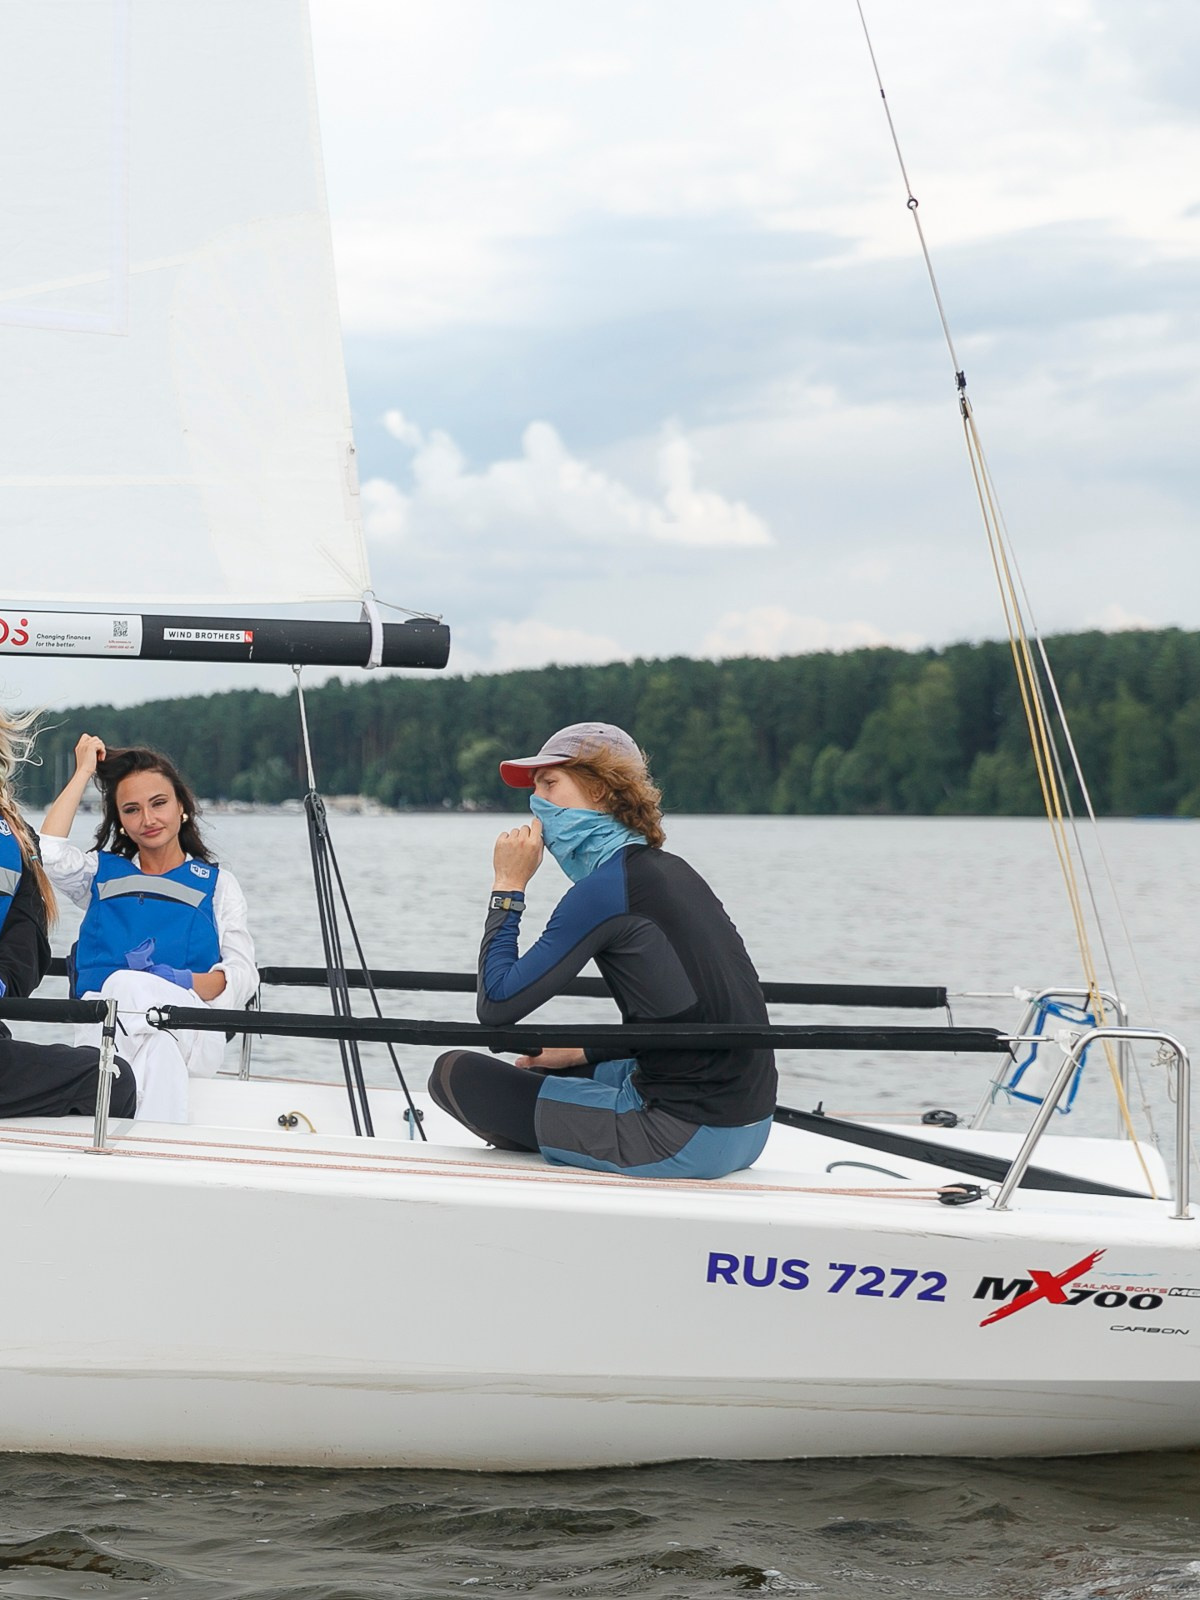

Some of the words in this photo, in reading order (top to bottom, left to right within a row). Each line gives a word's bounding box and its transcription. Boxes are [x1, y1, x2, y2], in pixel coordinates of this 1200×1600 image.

[36, 633, 65, 641] Changing
[195, 631, 241, 640] BROTHERS
[706, 1251, 810, 1291] RUS
[827, 1262, 948, 1303] 7272
[1072, 1282, 1121, 1291] SAILING
[1125, 1285, 1168, 1294] BOATS
[1110, 1325, 1190, 1335] CARBON
